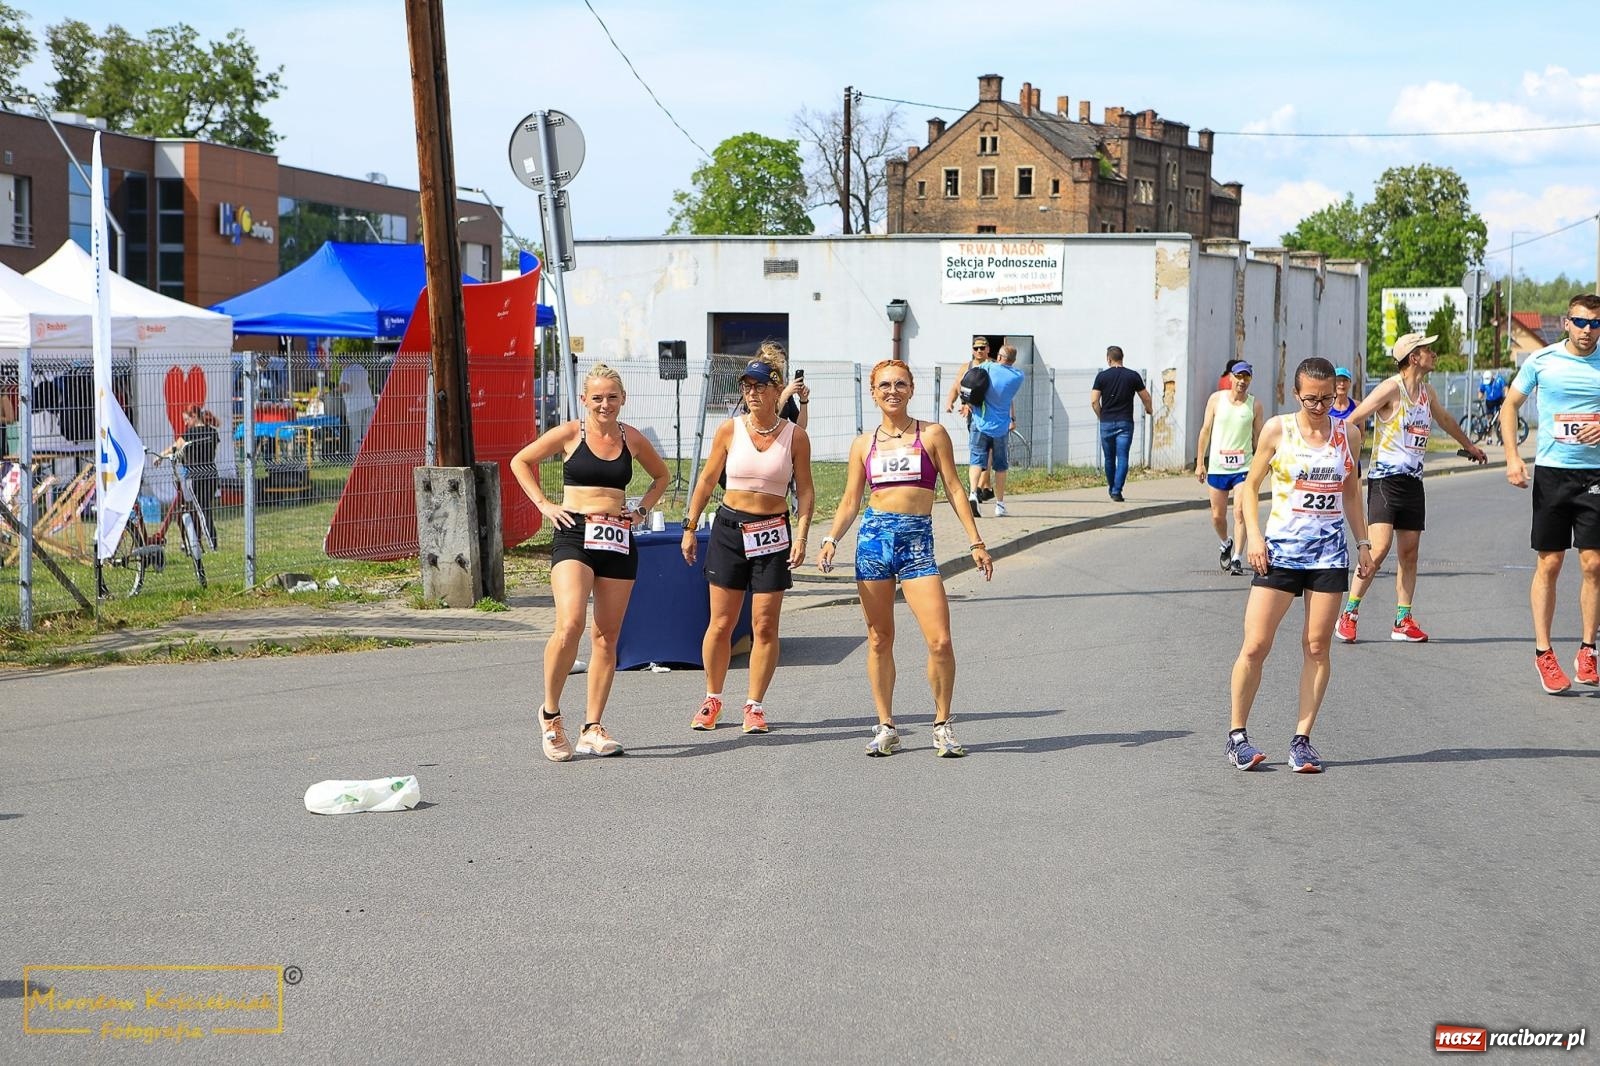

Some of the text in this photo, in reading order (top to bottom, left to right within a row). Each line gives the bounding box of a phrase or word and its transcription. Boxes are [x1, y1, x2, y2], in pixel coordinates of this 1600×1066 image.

[959, 241, 1045, 255] TRWA NABÓR
[946, 257, 1057, 269] Sekcja Podnoszenia
[946, 268, 995, 281] Ciężarów
[1563, 423, 1588, 435] 16
[880, 457, 910, 472] 192
[1302, 493, 1336, 510] 232
[593, 525, 624, 543] 200
[753, 529, 781, 547] 123
